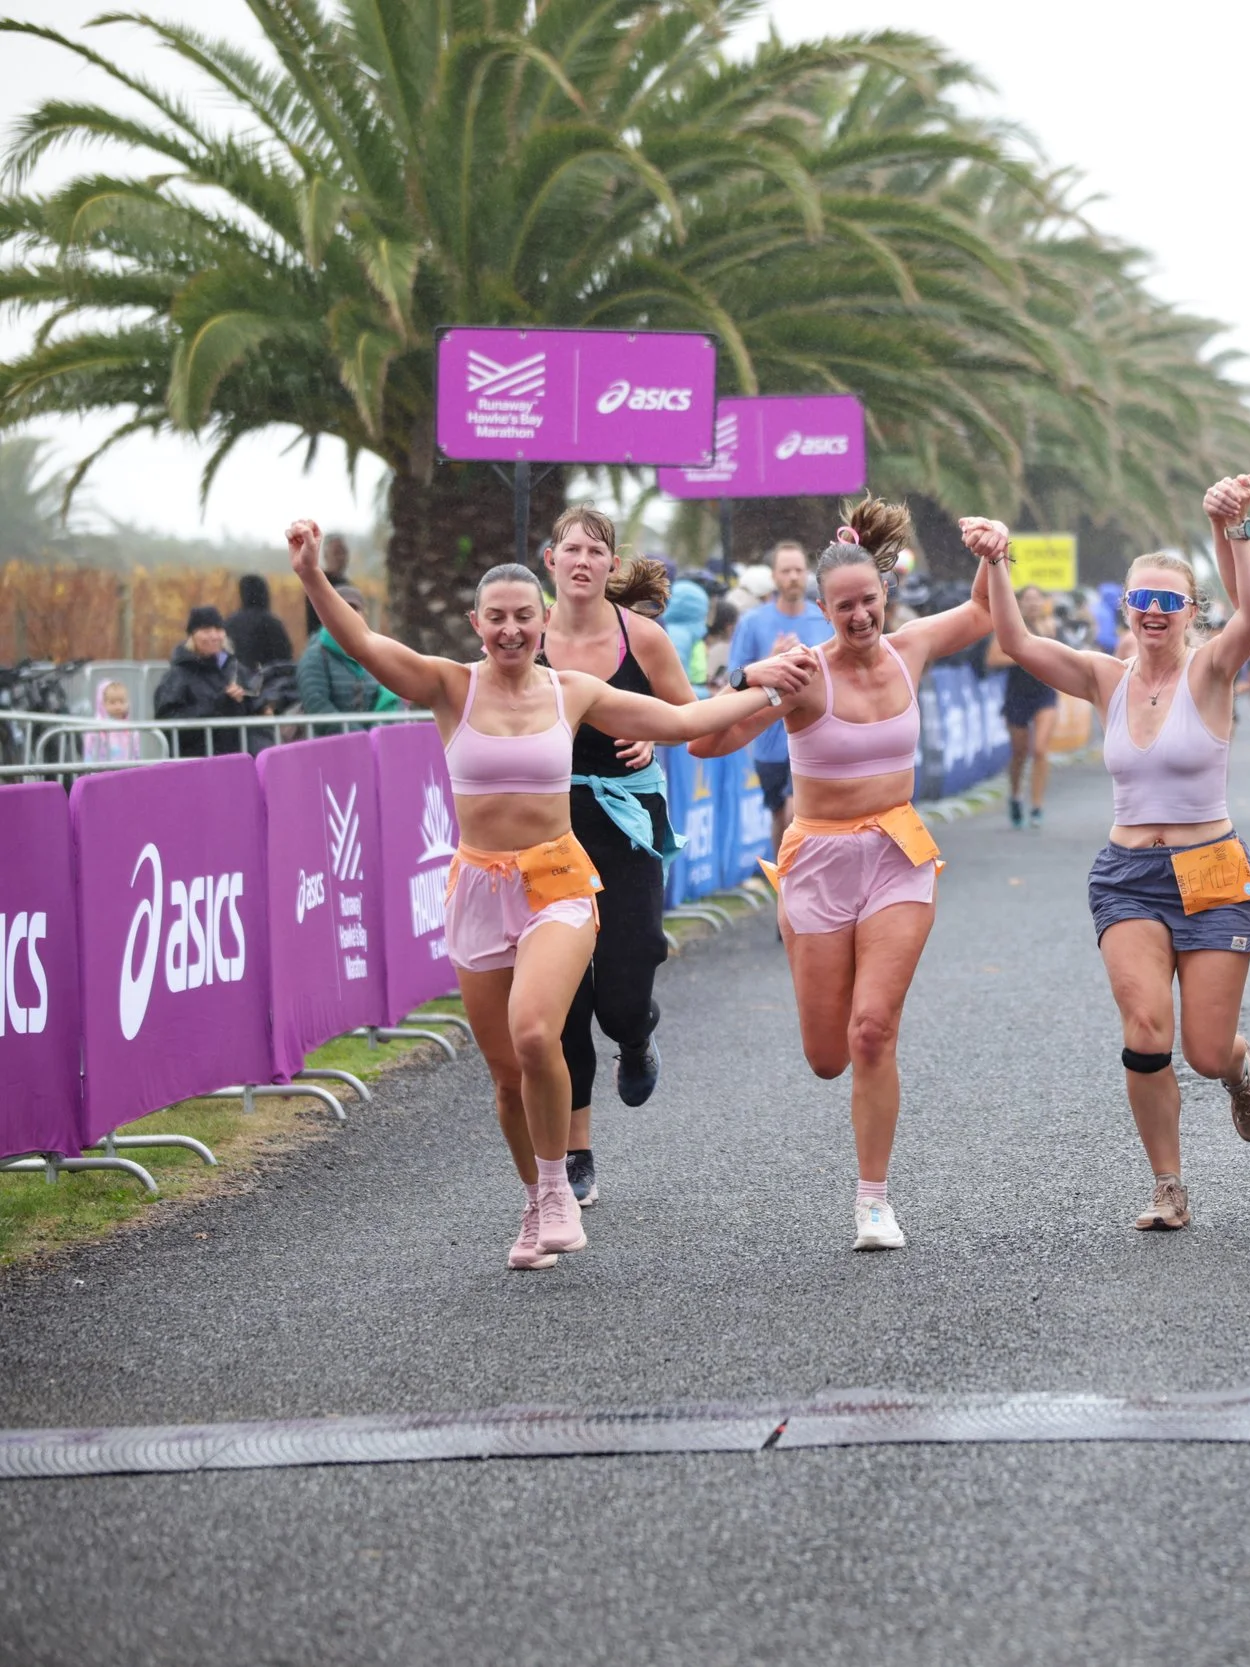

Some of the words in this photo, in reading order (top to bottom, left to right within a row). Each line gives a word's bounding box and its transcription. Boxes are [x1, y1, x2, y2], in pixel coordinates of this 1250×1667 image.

[478, 398, 533, 414] Runaway
[467, 411, 518, 425] Hawke's
[520, 412, 544, 428] Bay
[476, 425, 535, 438] Marathon
[1188, 860, 1241, 894] EMILY
[0, 911, 48, 1035] ics
